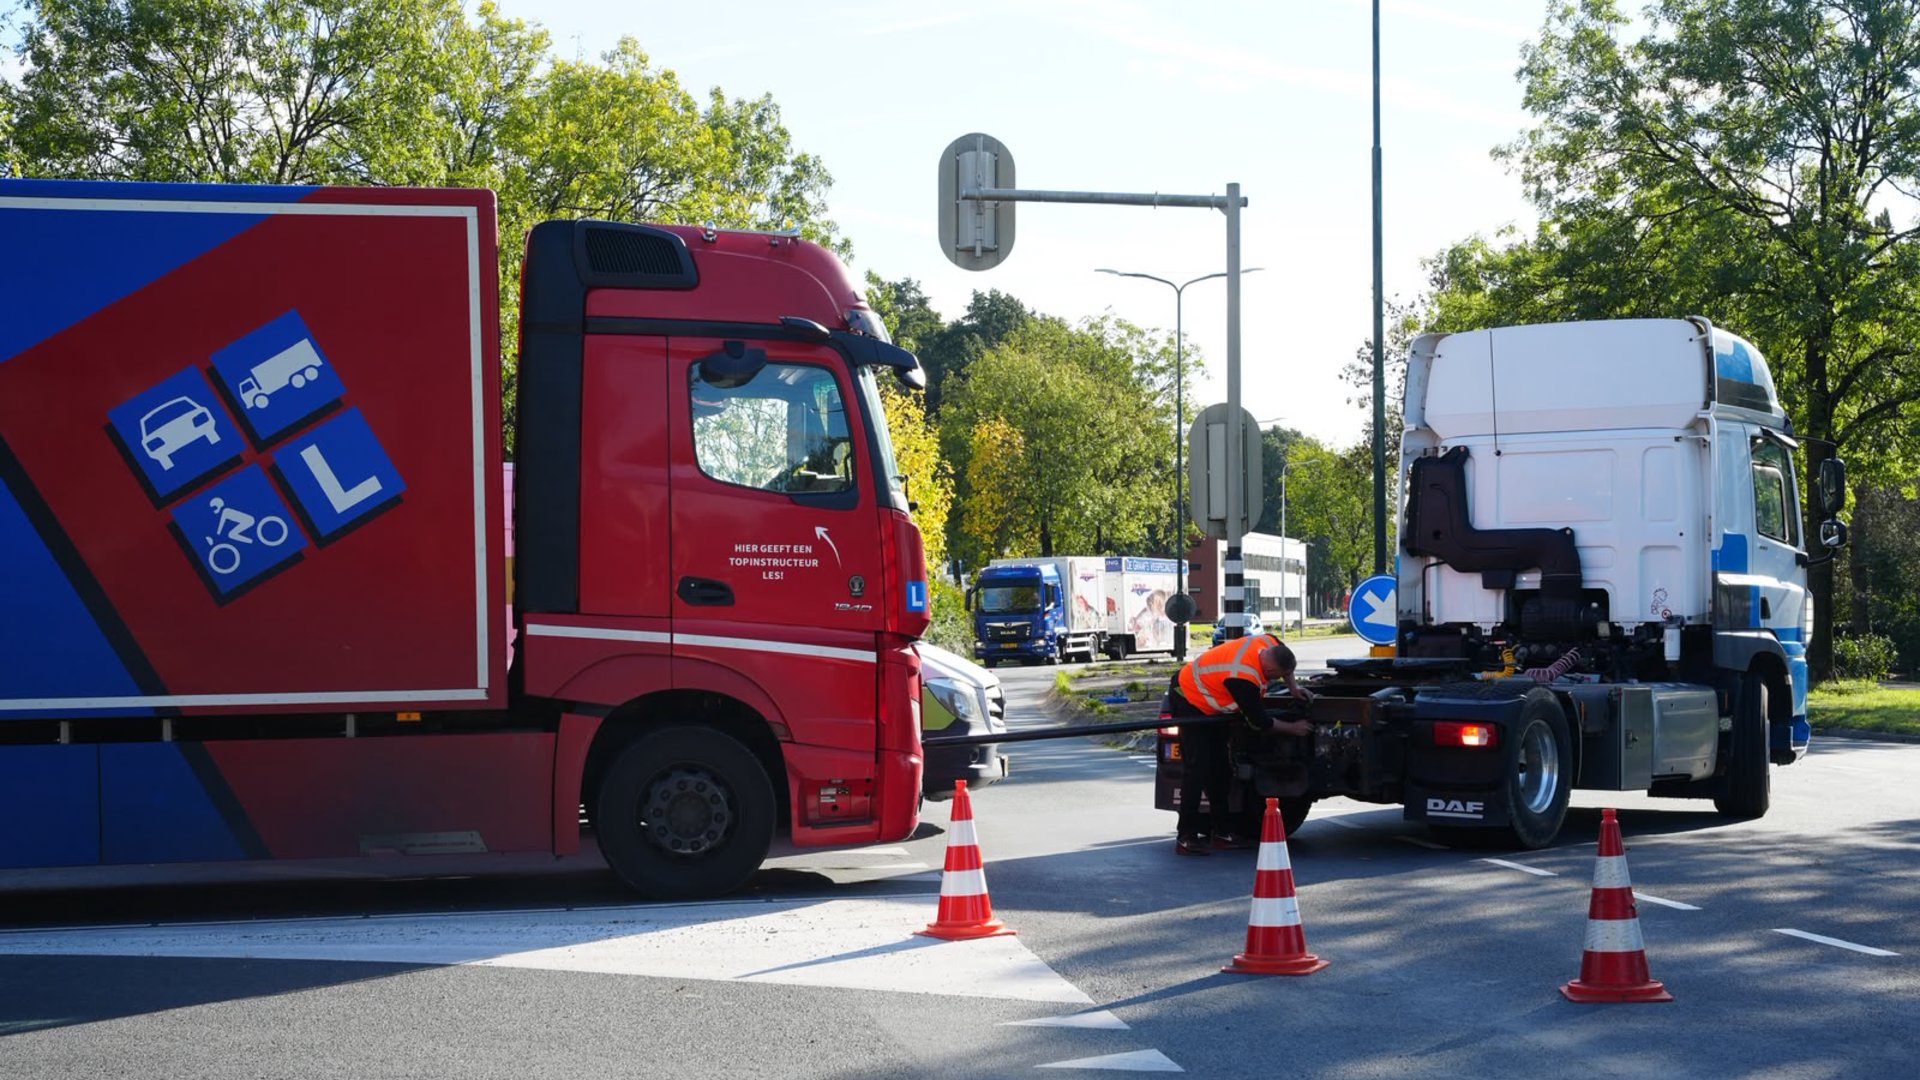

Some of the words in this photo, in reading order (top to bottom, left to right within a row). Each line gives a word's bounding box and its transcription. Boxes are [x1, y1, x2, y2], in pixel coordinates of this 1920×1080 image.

[300, 444, 383, 514] L
[734, 544, 758, 553] HIER
[760, 544, 791, 553] GEEFT
[793, 545, 812, 553] EEN
[729, 557, 819, 567] TOPINSTRUCTEUR
[762, 571, 784, 580] LES!
[911, 586, 923, 607] L
[1427, 798, 1484, 813] DAF
